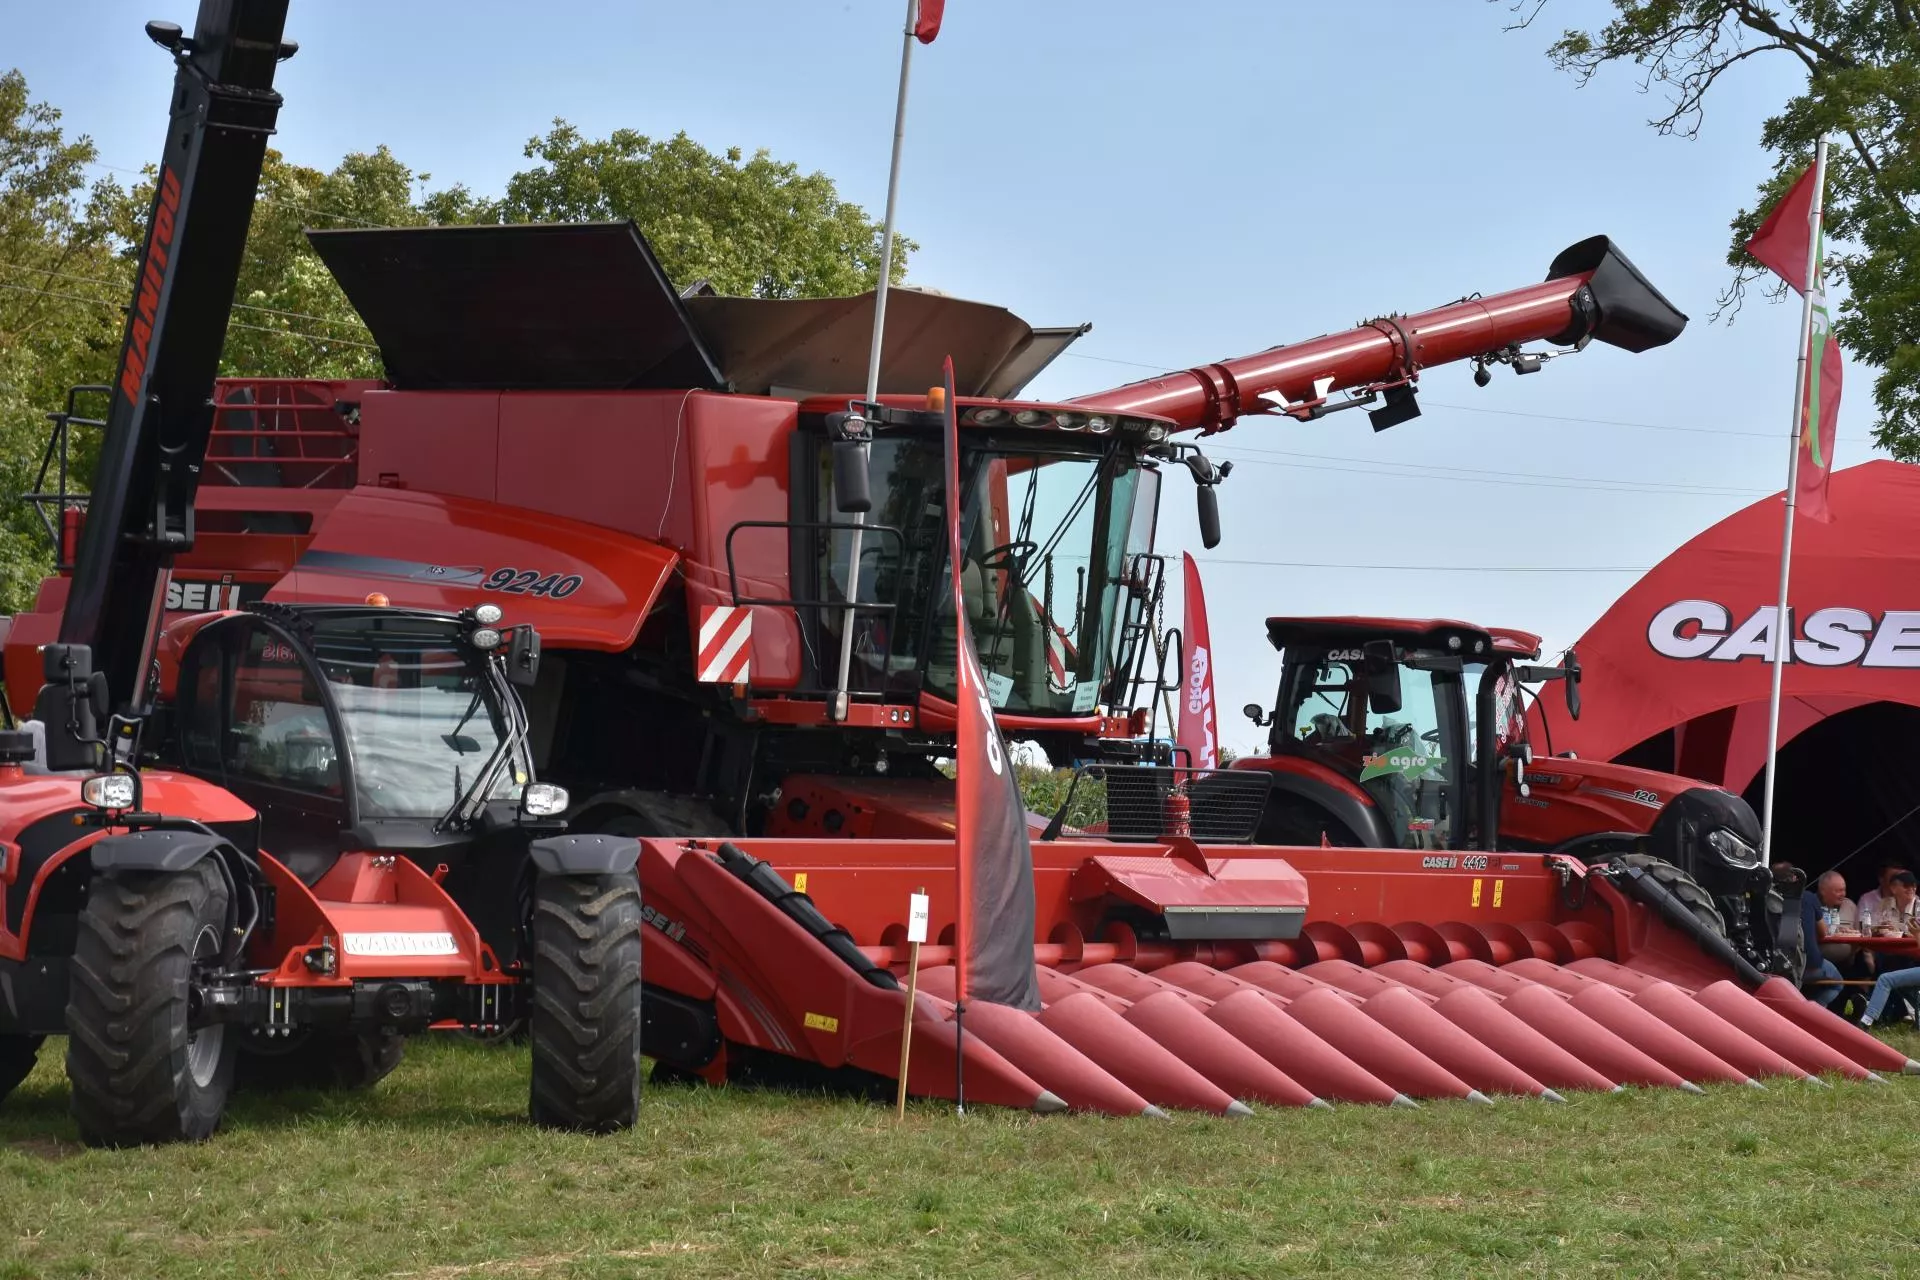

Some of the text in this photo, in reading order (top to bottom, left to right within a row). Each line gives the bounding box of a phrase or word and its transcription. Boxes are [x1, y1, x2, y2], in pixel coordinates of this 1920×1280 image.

[120, 164, 181, 408] MANITOU
[165, 581, 206, 610] SE
[482, 567, 584, 600] 9240
[1646, 599, 1920, 668] CASE
[1390, 756, 1428, 770] agro
[1634, 789, 1657, 803] 120
[1422, 857, 1449, 869] CASE
[1462, 856, 1488, 871] 4412
[641, 905, 669, 930] SE
